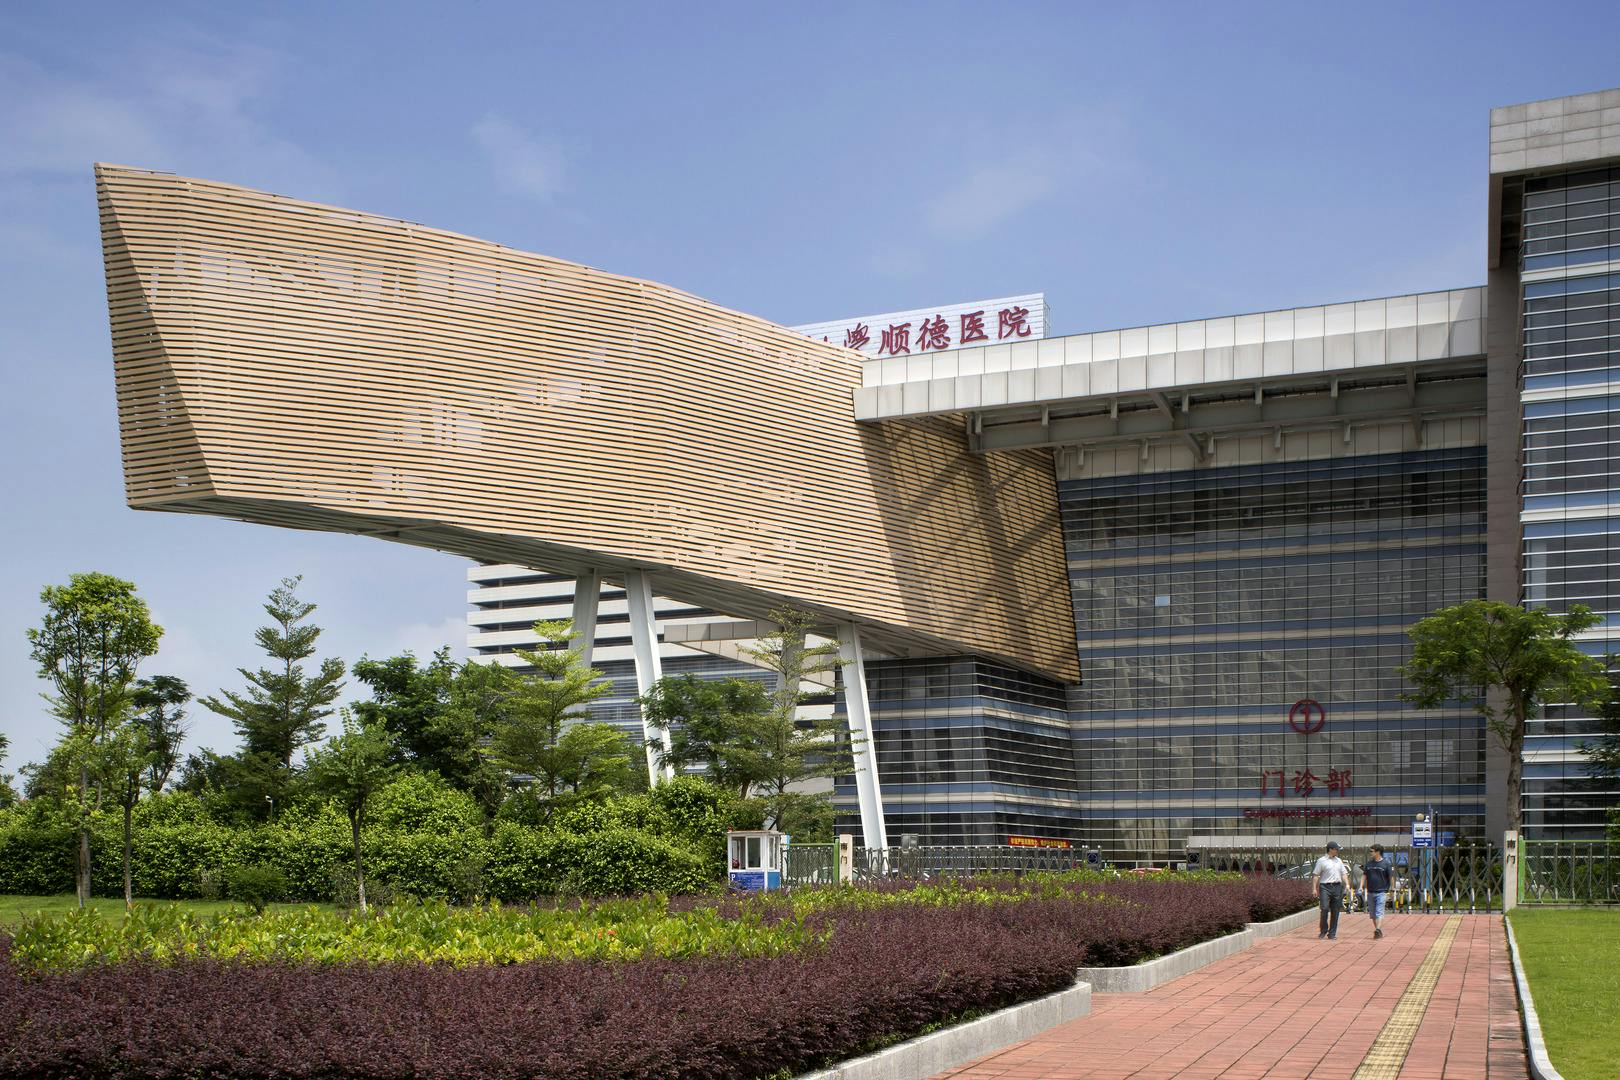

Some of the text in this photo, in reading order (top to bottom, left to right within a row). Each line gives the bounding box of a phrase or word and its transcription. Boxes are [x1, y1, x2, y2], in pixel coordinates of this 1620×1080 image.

[808, 306, 1031, 355] 学顺德医院
[1261, 767, 1353, 797] 门诊部
